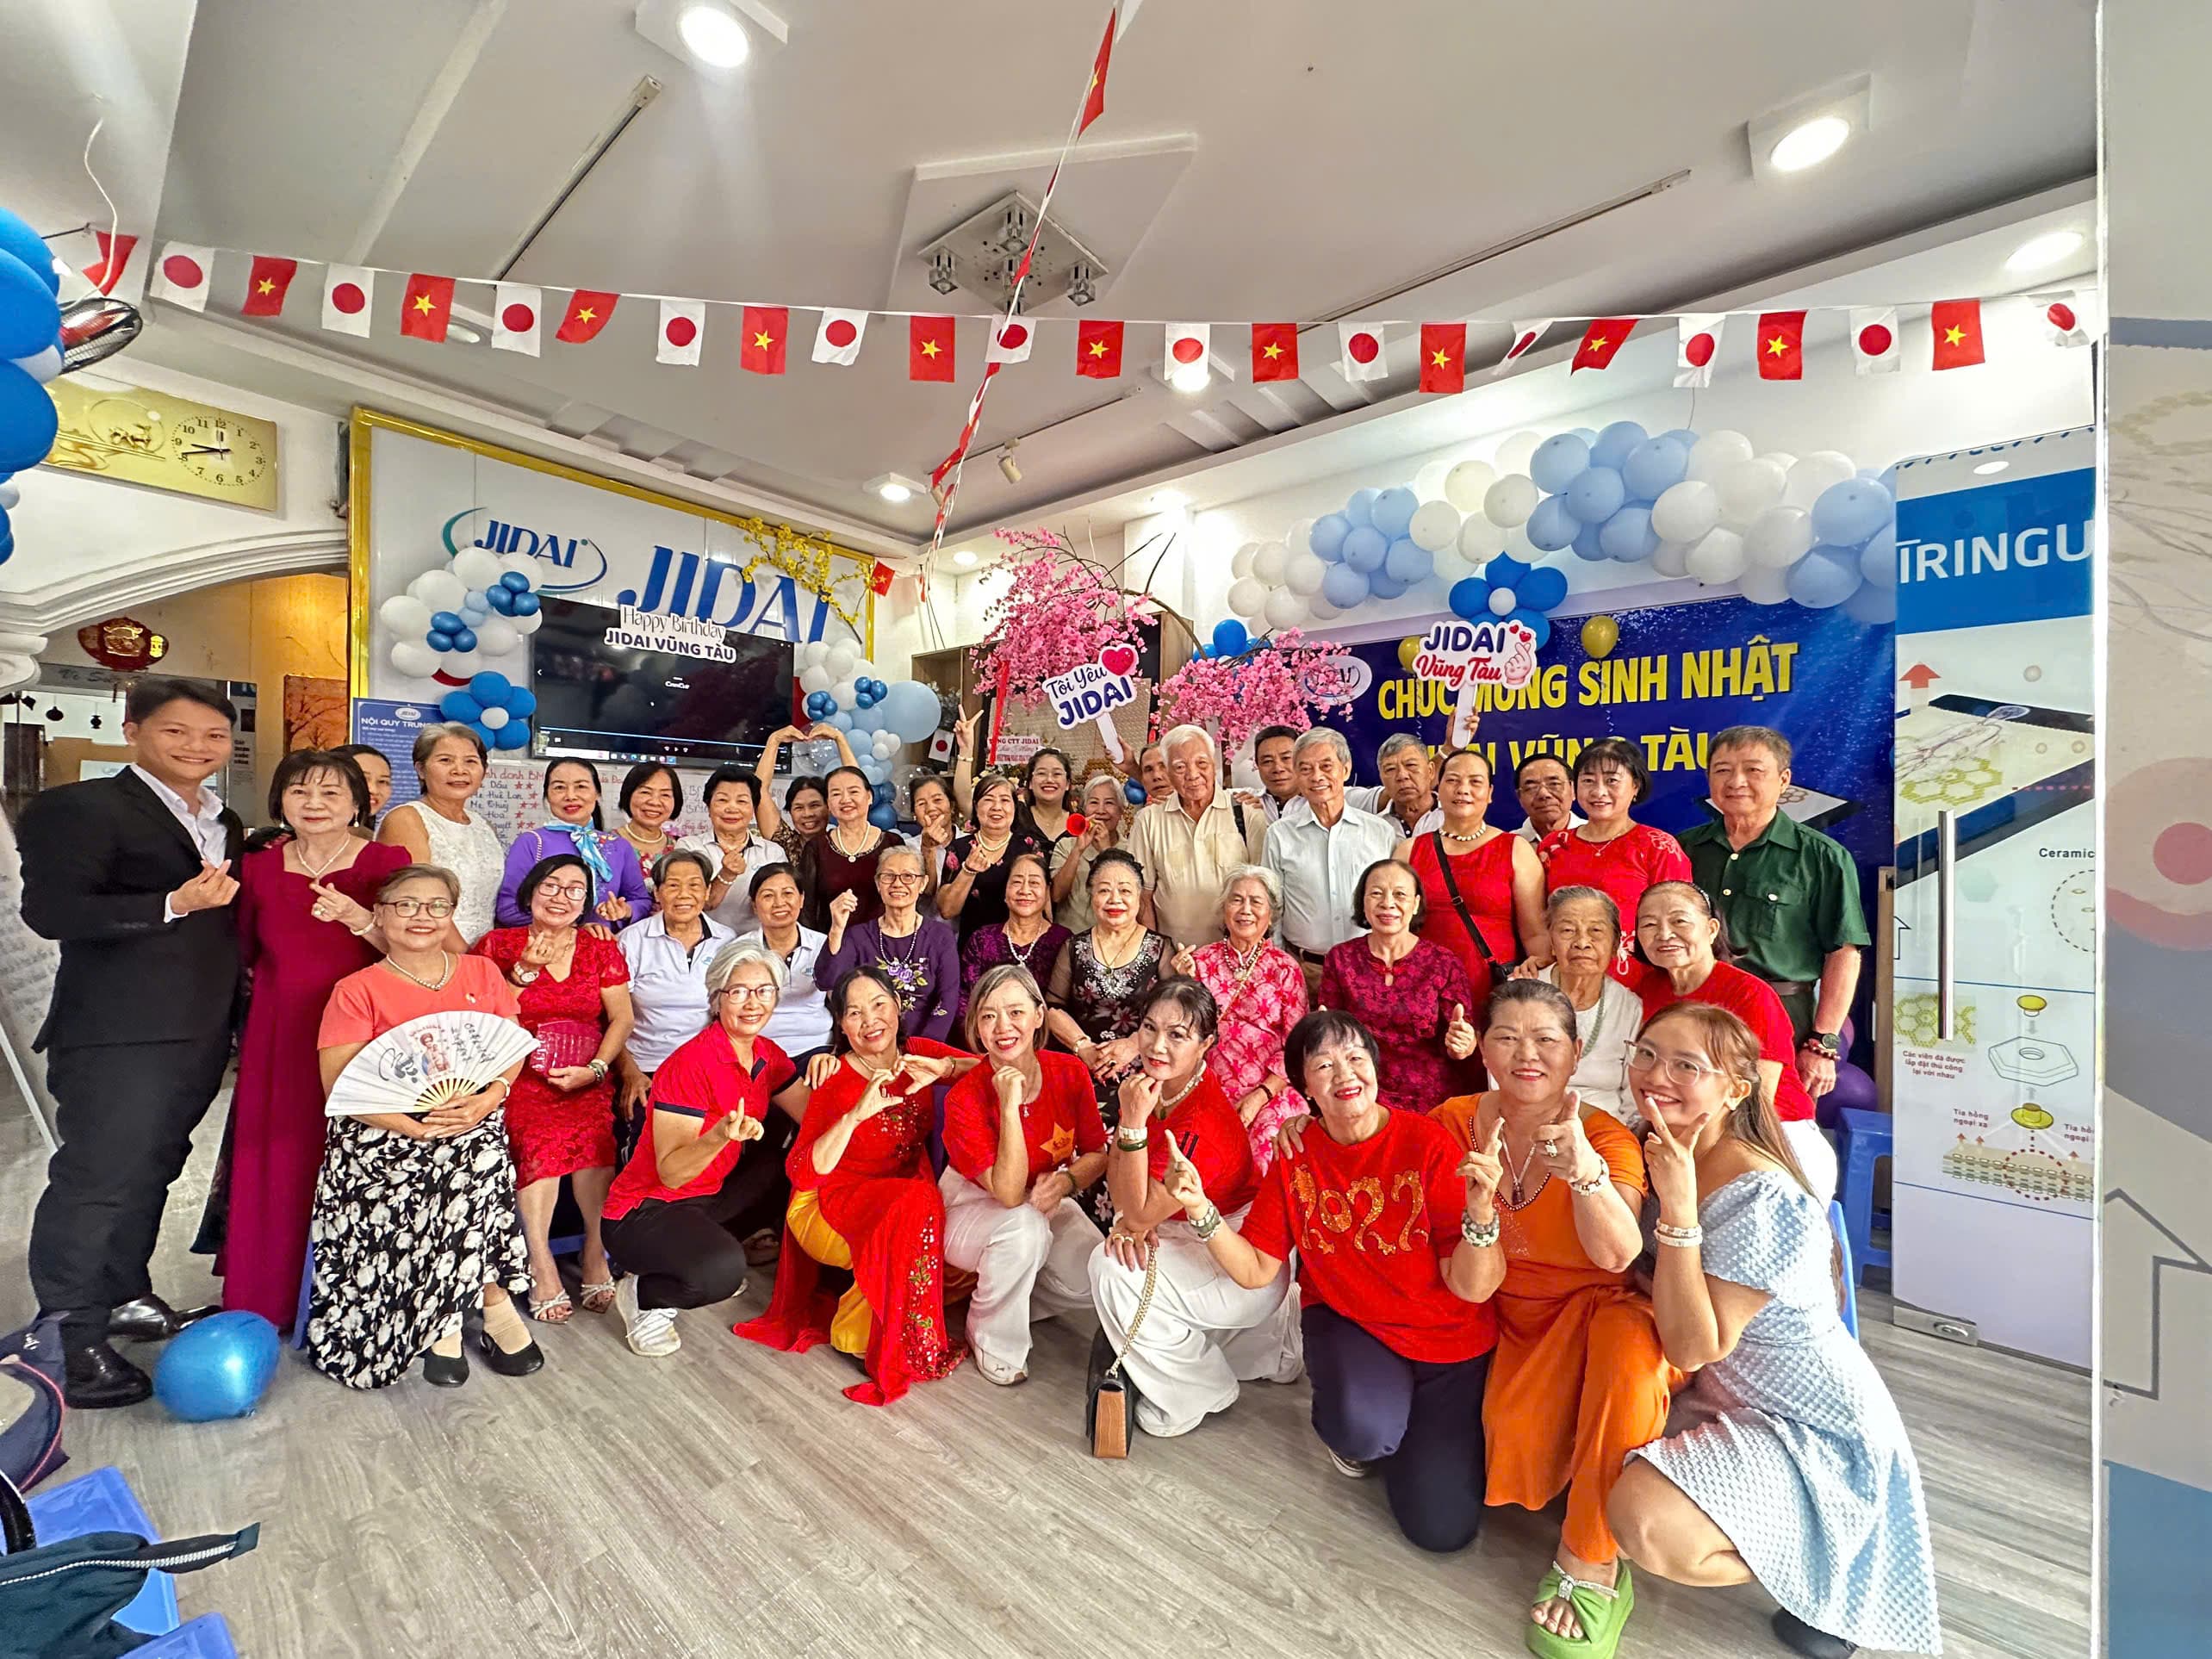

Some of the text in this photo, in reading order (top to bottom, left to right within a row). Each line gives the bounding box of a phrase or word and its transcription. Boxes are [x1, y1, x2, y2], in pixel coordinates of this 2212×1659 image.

[183, 425, 196, 434] 10
[197, 419, 208, 429] 11
[215, 419, 227, 429] 12
[175, 438, 183, 446] 9
[249, 441, 257, 450] 2
[197, 466, 205, 475] 7
[215, 474, 224, 483] 6
[474, 519, 577, 569] JIDAI
[617, 545, 830, 643] JIDAI
[624, 606, 725, 641] Happy Birthday
[606, 631, 733, 660] JIDAI VŨNG TÀU
[1424, 625, 1506, 654] JIDAI
[1415, 654, 1501, 687] Vũng Tàu
[1578, 655, 1668, 706] SINH
[1681, 634, 1799, 702] NHẬT
[1046, 666, 1108, 699] Tôi Yêu
[1059, 676, 1133, 725] JIDAI
[361, 717, 379, 726] NỘI
[380, 718, 401, 727] QUY
[2038, 847, 2096, 860] Ceramic
[2064, 1123, 2078, 1132] Tia
